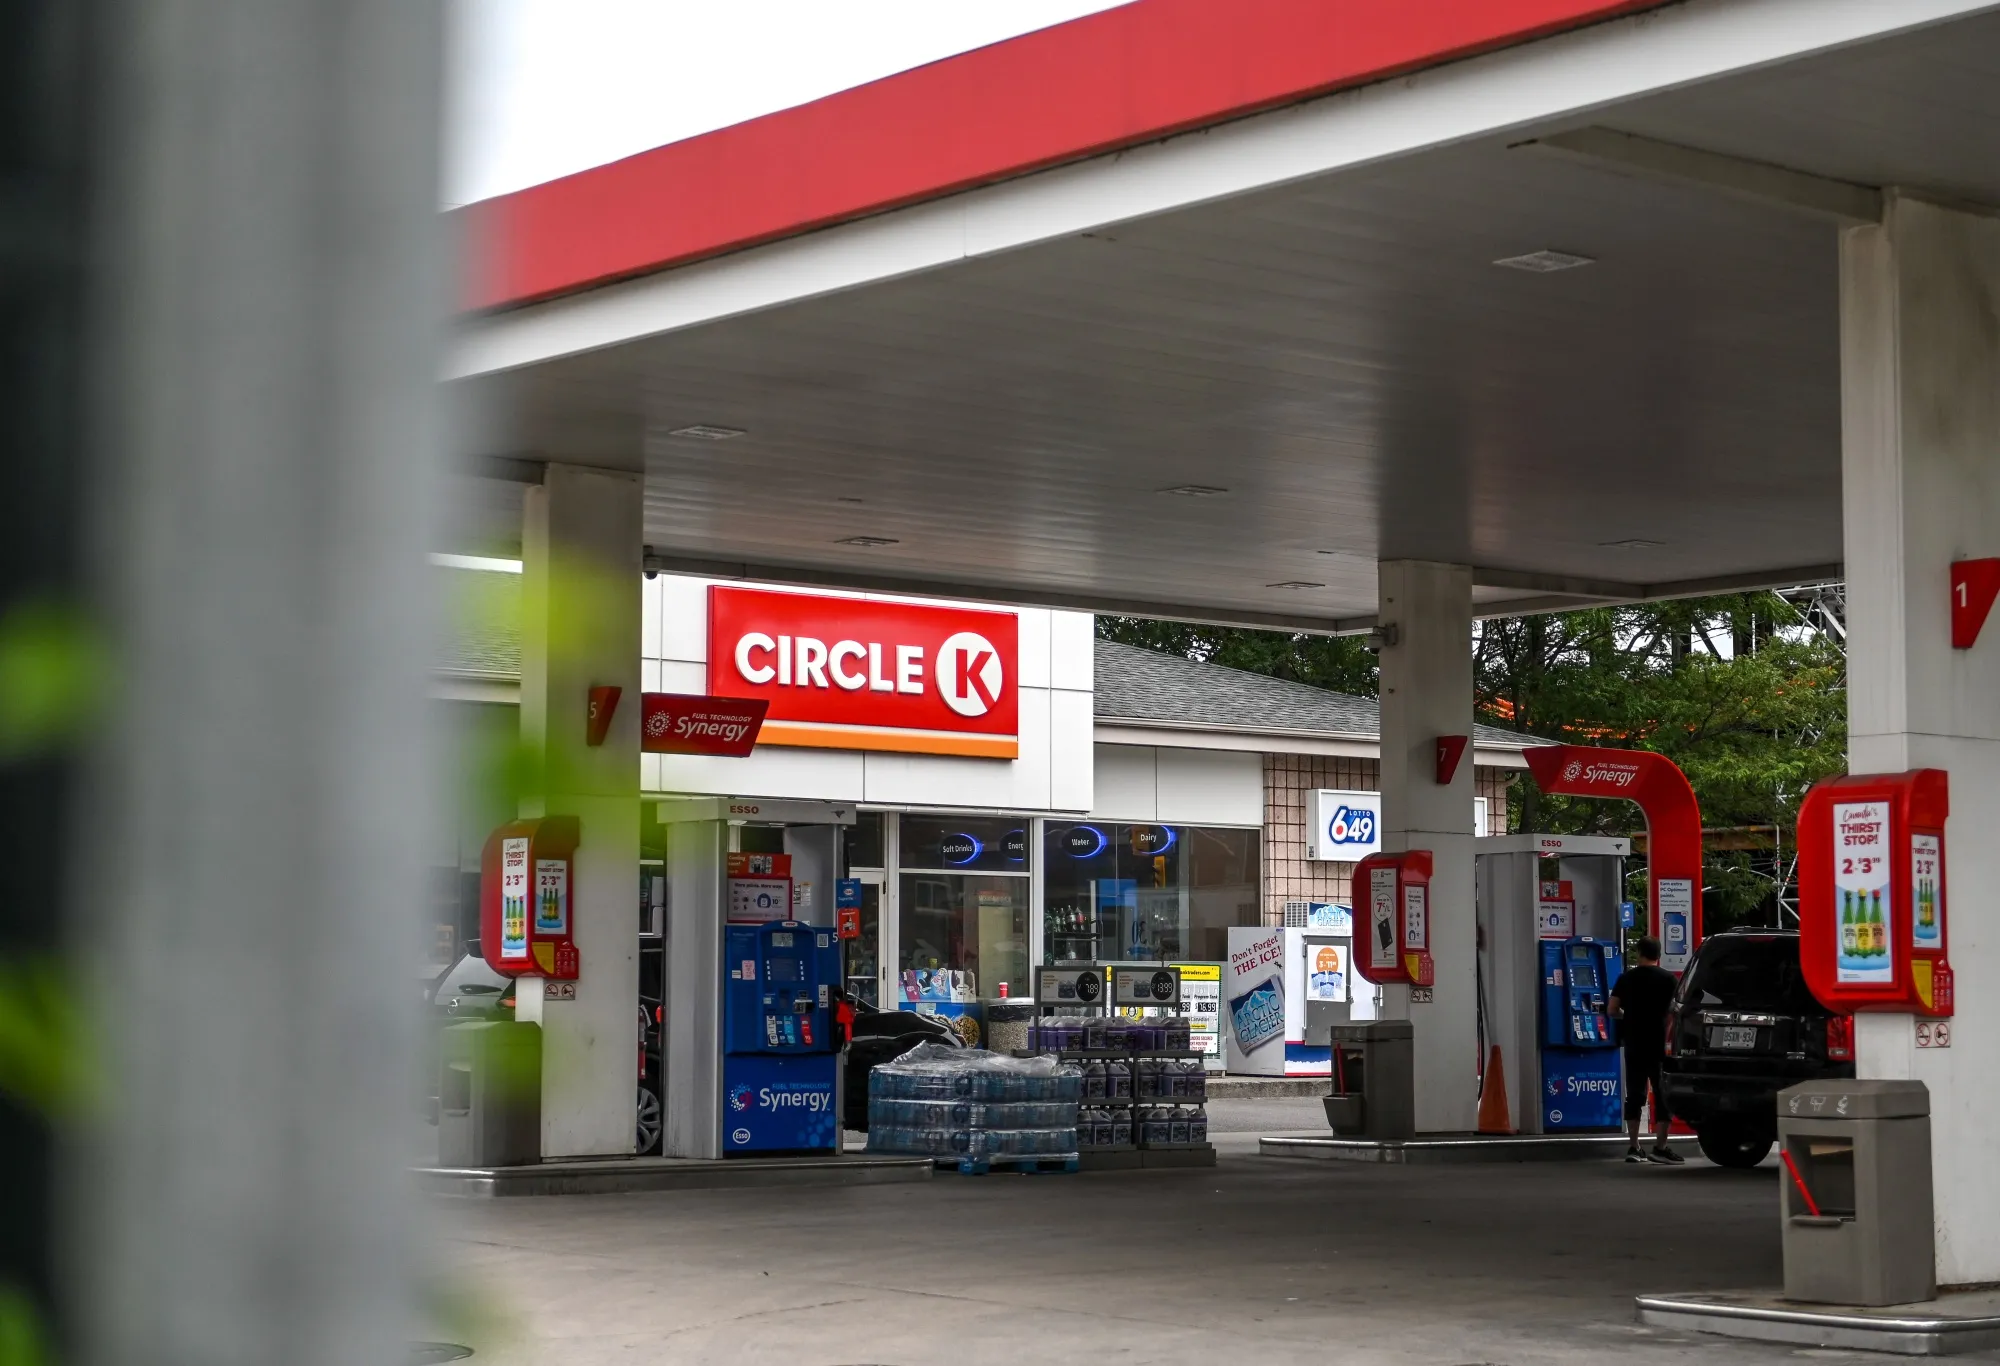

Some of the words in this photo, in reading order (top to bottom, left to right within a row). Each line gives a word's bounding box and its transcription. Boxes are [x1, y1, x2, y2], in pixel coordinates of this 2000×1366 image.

[1956, 582, 1966, 608] 1
[734, 632, 924, 695] CIRCLE
[954, 648, 998, 710] K
[589, 702, 597, 718] 5
[709, 714, 752, 722] TECHNOLOGY
[674, 716, 749, 742] Synergy
[1439, 748, 1447, 762] 7
[1583, 766, 1636, 786] Synergy
[730, 806, 760, 814] ESSO
[1840, 822, 1882, 834] THIRST
[1072, 838, 1090, 846] Water
[1140, 834, 1156, 842] Dairy
[1844, 834, 1878, 846] STOP!
[1318, 909, 1344, 920] ARCTIC
[832, 934, 838, 942] 5
[1231, 948, 1252, 963] Don't
[1252, 935, 1279, 953] Forget
[1234, 957, 1258, 976] THE
[1260, 945, 1282, 964] ICE!
[1237, 994, 1280, 1030] ARCTIC
[1240, 1012, 1284, 1043] GLACIER
[1568, 1076, 1616, 1096] Synergy
[760, 1088, 830, 1112] Synergy
